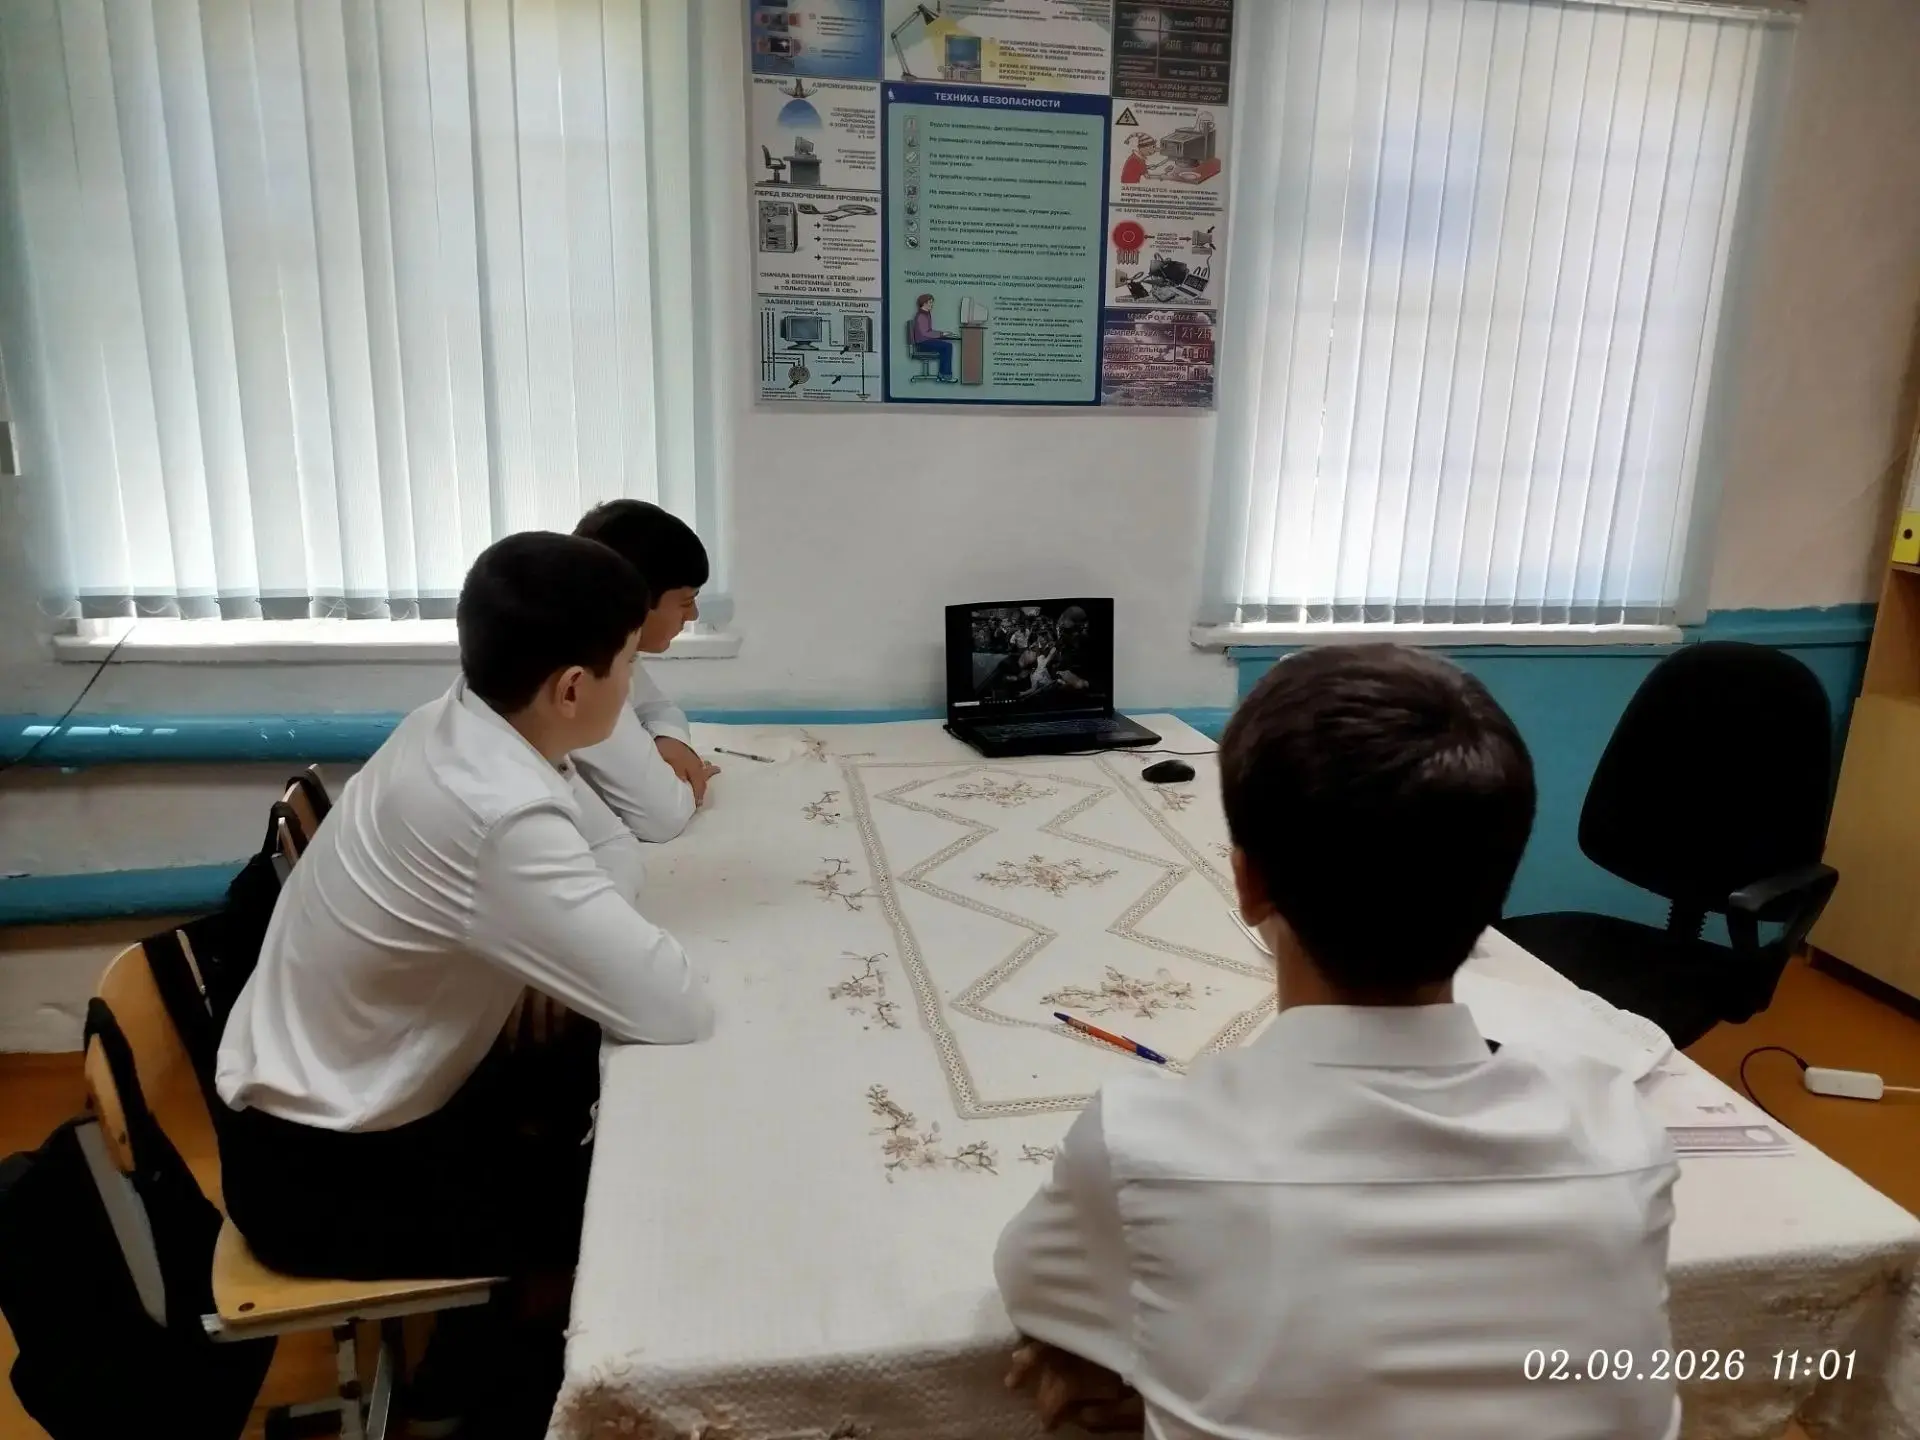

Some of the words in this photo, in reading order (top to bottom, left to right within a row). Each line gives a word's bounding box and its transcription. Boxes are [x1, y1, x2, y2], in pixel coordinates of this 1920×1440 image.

[934, 92, 979, 103] ТЕХНИКА
[982, 96, 1061, 108] БЕЗОПАСНОСТИ
[781, 192, 834, 200] ВКЛЮЧЕНИЕМ
[939, 279, 996, 287] придерживайтесь
[765, 298, 814, 306] ЗАЗЕМЛЕНИЕ
[817, 300, 869, 308] ОБЯЗАТЕЛЬНО
